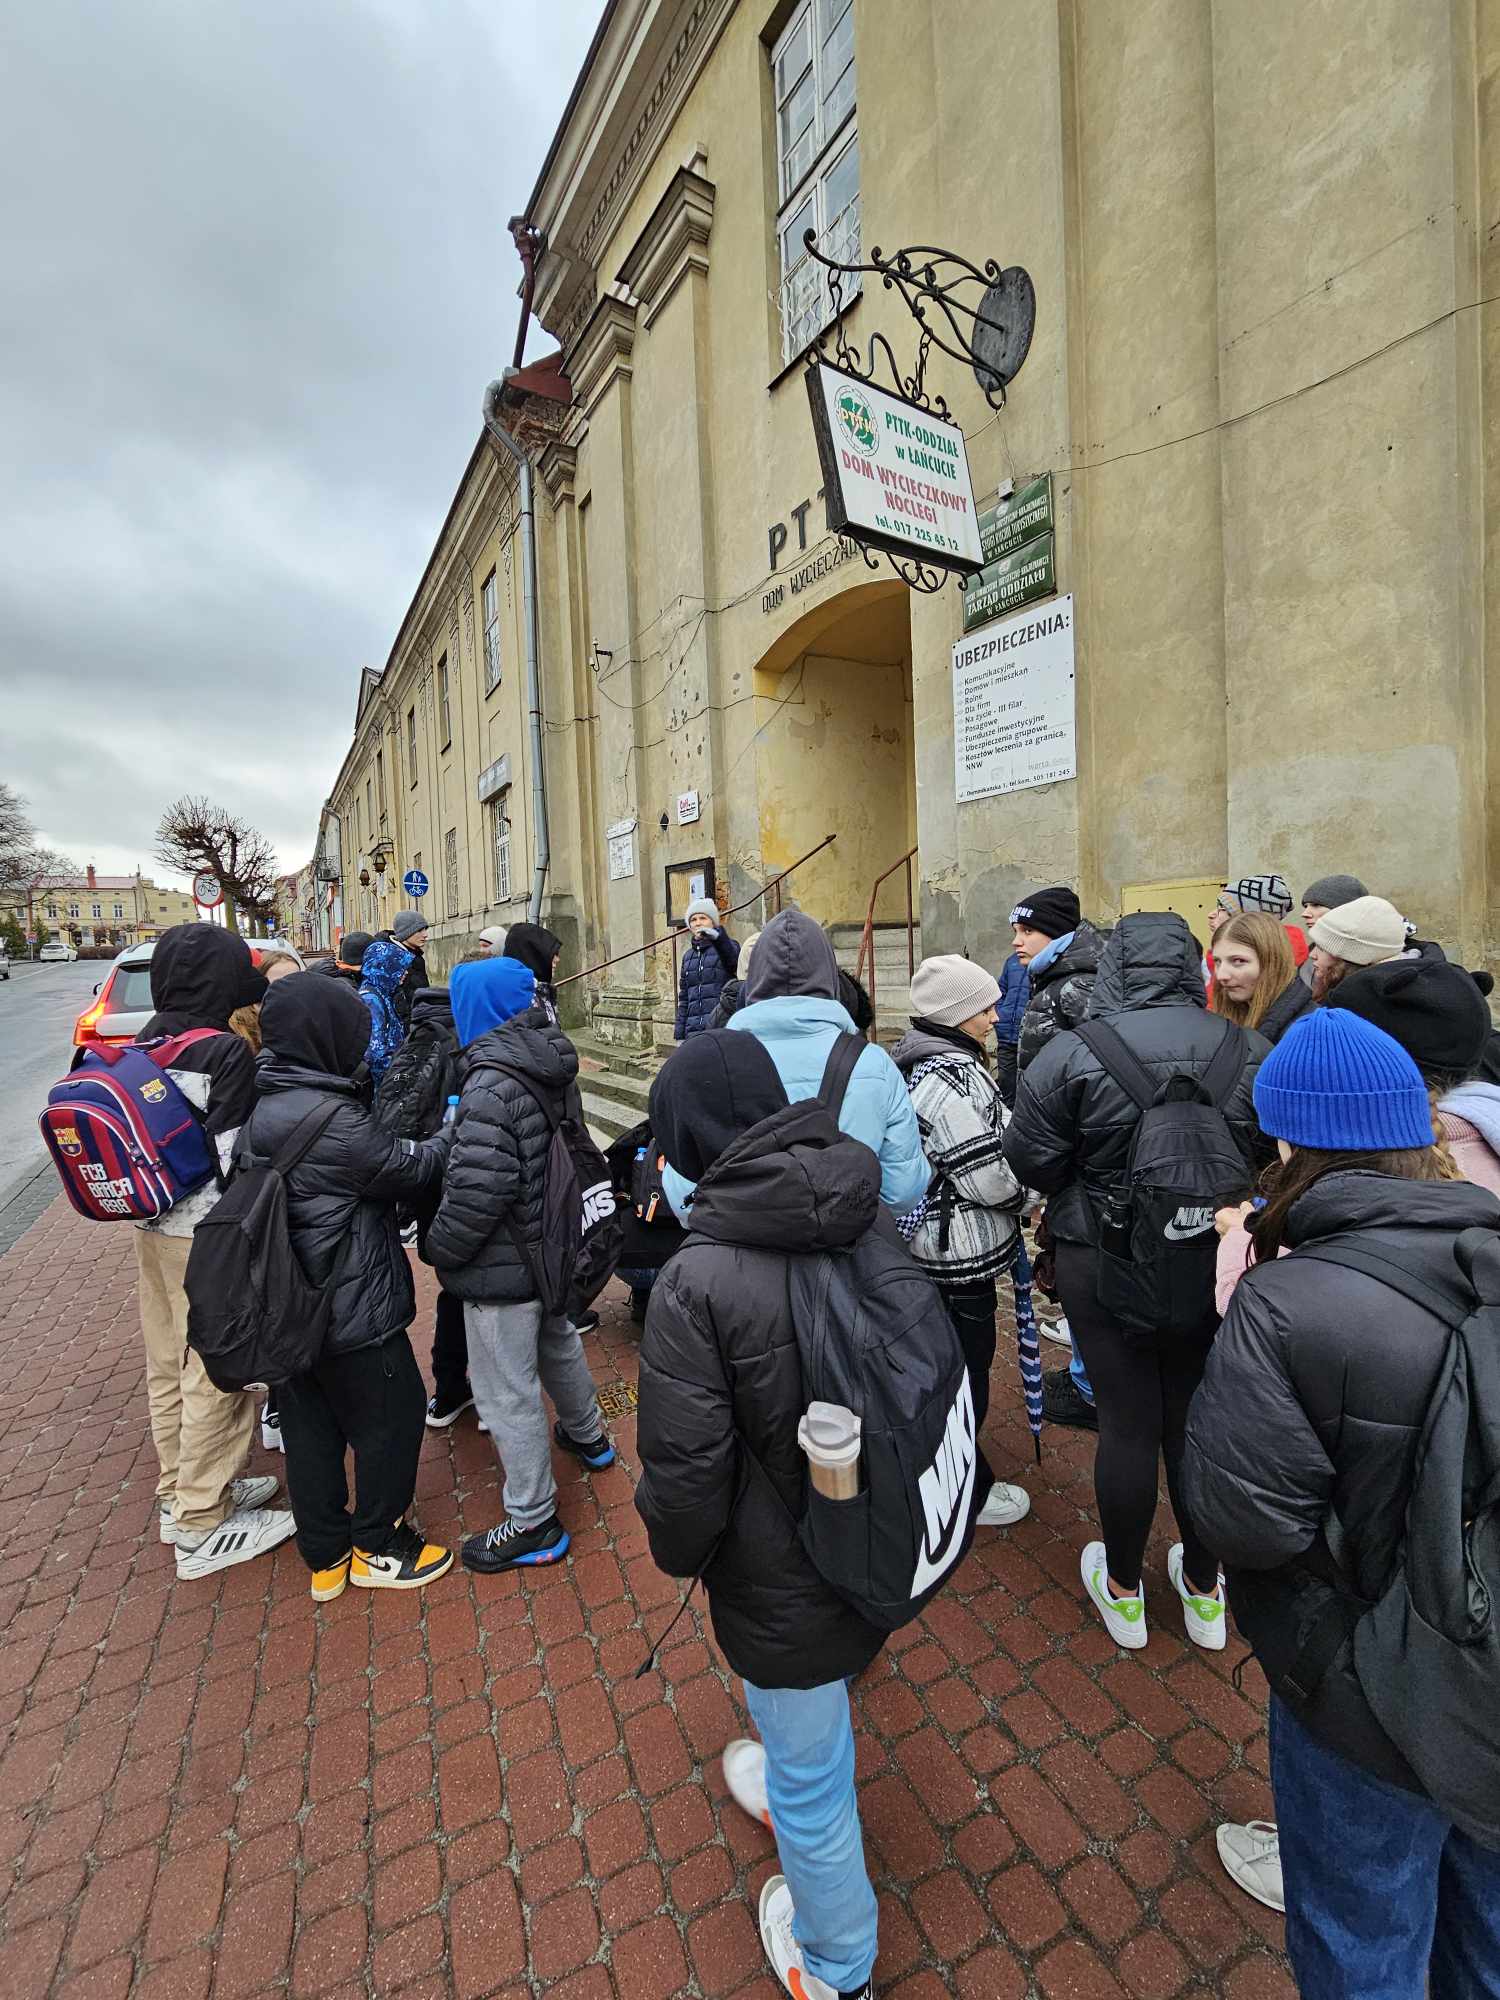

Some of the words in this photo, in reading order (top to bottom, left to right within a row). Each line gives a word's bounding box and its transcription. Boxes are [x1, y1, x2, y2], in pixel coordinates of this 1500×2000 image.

[885, 411, 960, 458] PTTK-ODDZIAŁ
[908, 446, 957, 480] ŁAŃCUCIE
[841, 449, 875, 480] DOM
[876, 464, 967, 513] WYCIECZKOWY
[884, 490, 938, 525] NOCLEGI
[875, 514, 892, 530] tel.
[893, 520, 912, 536] 017
[914, 527, 932, 542] 225
[934, 535, 945, 547] 45
[948, 537, 959, 552] 12
[1001, 568, 1045, 599] ODDZIAŁU
[762, 584, 784, 613] DOM
[955, 613, 1070, 670] UBEZPIECZENIA:
[964, 661, 1015, 686] Komunikacyjne
[964, 681, 990, 695] Domów
[964, 694, 983, 705] Rolne
[965, 705, 975, 714] Dla
[977, 700, 991, 710] firm
[965, 715, 974, 723] Na
[1008, 700, 1023, 711] filar
[965, 728, 996, 743] Fundusze
[997, 713, 1045, 733] inwestycyjne
[965, 734, 1013, 752] Ubezpieczenia
[1014, 723, 1048, 740] grupowe
[995, 742, 1023, 754] leczenia
[1024, 737, 1033, 746] za
[966, 761, 983, 771] NNW
[79, 1163, 107, 1181] FCB
[1172, 1206, 1215, 1227] NIKE
[918, 1364, 976, 1557] NIKE
